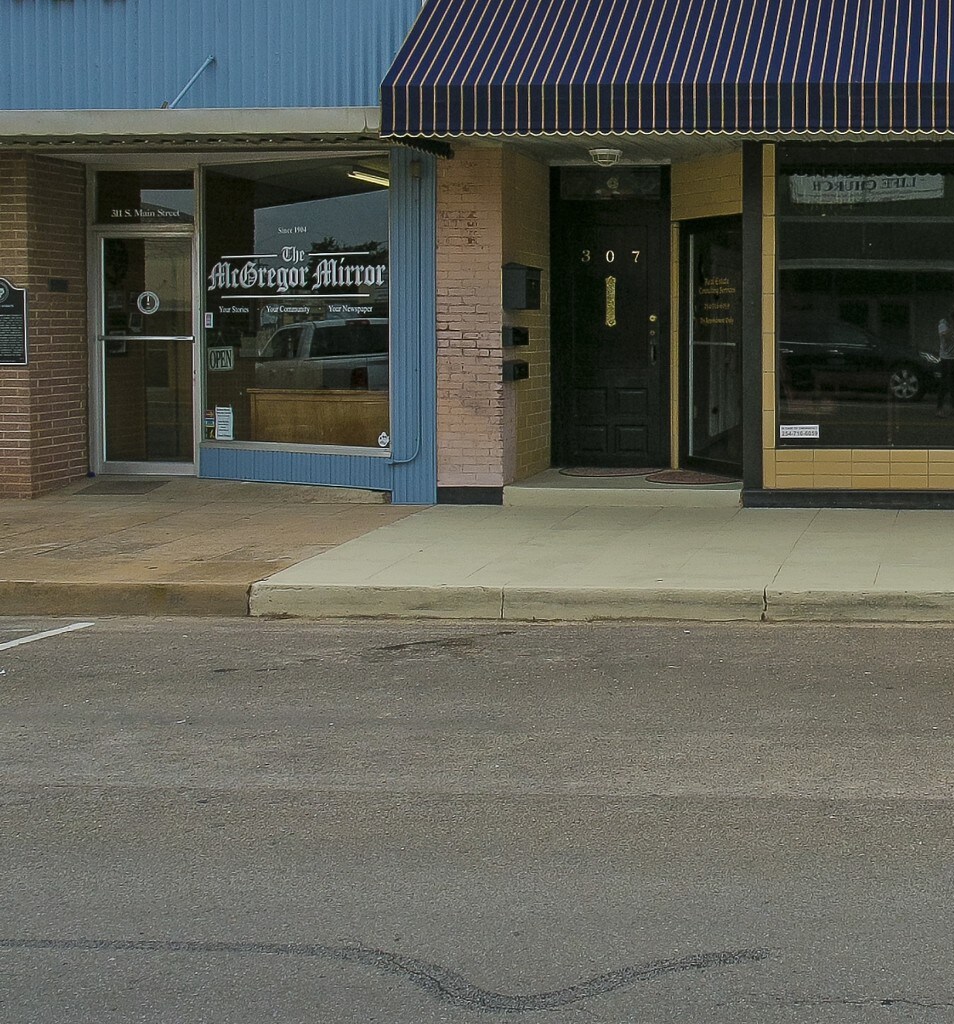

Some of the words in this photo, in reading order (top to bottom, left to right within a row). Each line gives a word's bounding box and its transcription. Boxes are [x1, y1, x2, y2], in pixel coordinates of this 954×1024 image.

[111, 209, 122, 217] 311
[134, 209, 155, 217] Main
[157, 208, 181, 217] Street
[277, 226, 293, 234] Since
[282, 246, 305, 264] The
[581, 249, 641, 263] 307
[207, 261, 309, 293] McGregor
[311, 257, 386, 291] Mirror
[231, 305, 249, 313] Stories
[266, 305, 279, 313] Your
[279, 306, 310, 314] Community
[328, 305, 341, 313] Your
[342, 305, 373, 314] Newspaper
[209, 350, 232, 369] OPEN
